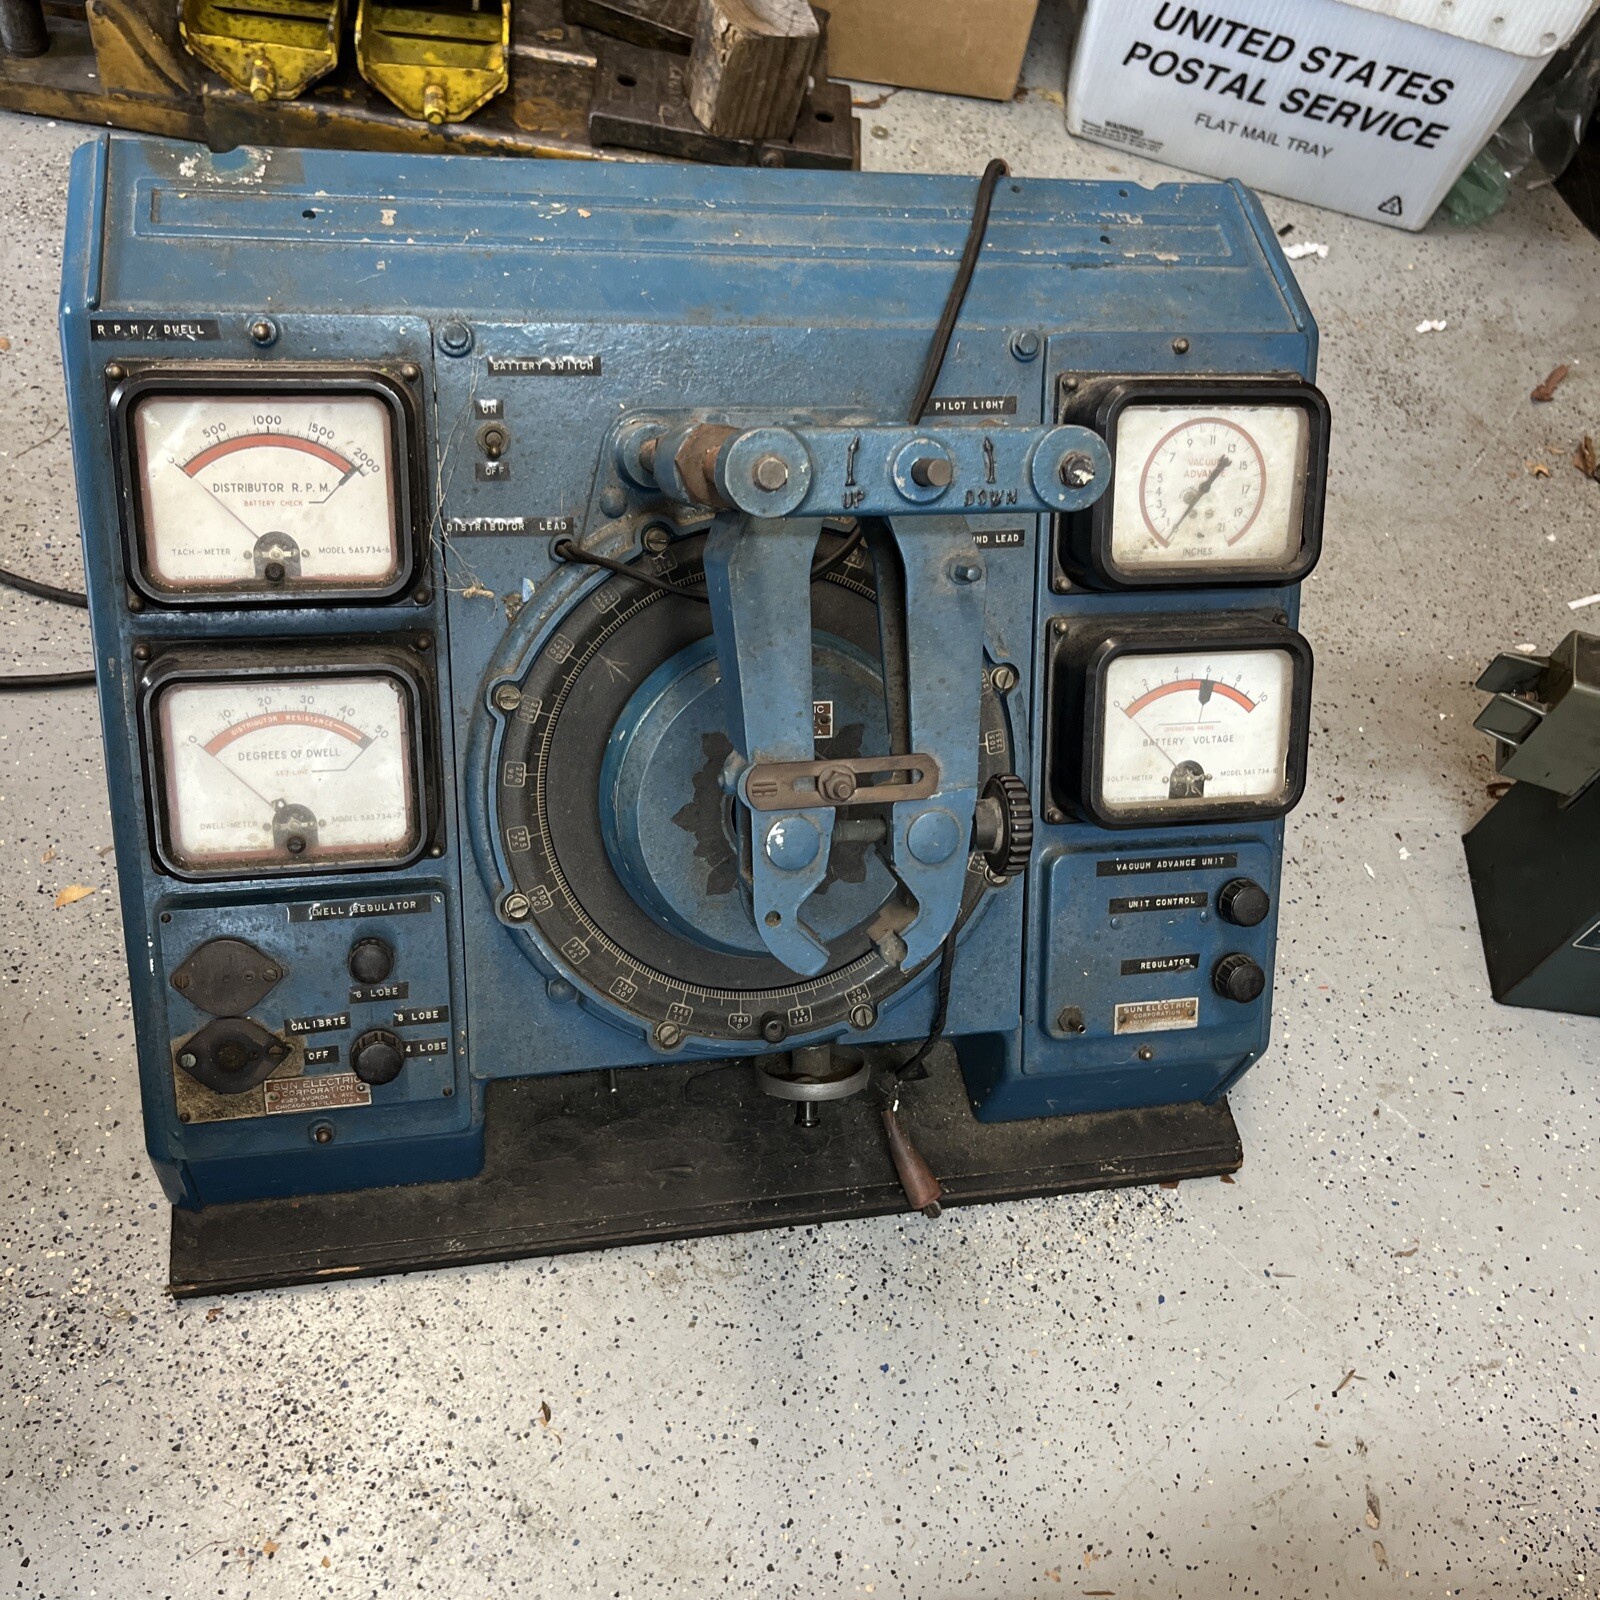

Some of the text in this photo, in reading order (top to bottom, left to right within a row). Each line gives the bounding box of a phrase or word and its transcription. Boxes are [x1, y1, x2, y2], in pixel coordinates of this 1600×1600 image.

[1153, 1, 1455, 106] UNITED STATES
[1122, 40, 1450, 149] POSTAL SERVICE
[1194, 112, 1334, 158] FLAT MAIL TRAY
[163, 324, 205, 335] DWELL
[493, 360, 594, 371] BATTERY SWITCH
[482, 404, 497, 414] ON
[934, 399, 1005, 411] PILOT LIGHT
[253, 415, 282, 426] 1000
[202, 422, 227, 439] 500
[308, 422, 336, 440] 1500
[1187, 438, 1194, 449] 9
[1210, 435, 1216, 445] 11
[1227, 443, 1237, 454] 13
[353, 447, 380, 474] 2000
[1169, 452, 1176, 463] 7
[1239, 461, 1248, 470] 15
[485, 467, 505, 476] OFF
[1157, 474, 1163, 484] 5
[213, 482, 284, 493] DISTRIBUTOR
[1156, 487, 1162, 496] 4
[1241, 485, 1250, 494] 17
[244, 499, 303, 507] BATTERY CHECK
[842, 489, 865, 509] UP
[964, 488, 1018, 508] DOWN
[1156, 500, 1163, 509] 3
[1161, 508, 1167, 518] 2
[1234, 507, 1243, 517] 19
[446, 520, 567, 531] DISTRIBUTOR LEAD
[1167, 518, 1171, 527] 1
[1217, 523, 1226, 532] 21
[995, 534, 1019, 543] LEAD
[319, 546, 346, 554] MODEL
[1182, 546, 1213, 557] INCHES
[1174, 666, 1179, 674] 4
[1205, 665, 1212, 673] 6
[1142, 678, 1148, 687] 2
[1236, 674, 1242, 682] 8
[257, 696, 272, 707] 20
[299, 694, 315, 705] 30
[1259, 691, 1268, 702] 10
[1113, 700, 1120, 708] 0
[220, 709, 231, 720] 10
[340, 705, 355, 717] 40
[231, 714, 334, 736] DISTRIBUTOR RESISTANCE
[374, 724, 389, 739] 50
[188, 735, 197, 744] 0
[1142, 734, 1234, 747] BATTERY VOLTAGE
[238, 748, 341, 761] DEGREES OF DWELL
[515, 766, 523, 783] 270
[1220, 769, 1242, 777] MODEL
[1116, 857, 1225, 871] VACUUM ADVANCE UNIT
[531, 896, 541, 907] 60
[537, 889, 549, 906] 300
[1128, 897, 1196, 909] UNIT CONTROL
[352, 901, 417, 913] REGULATOR
[571, 941, 586, 957] 315
[1140, 958, 1191, 970] REGULATOR
[371, 987, 398, 997] LOBE
[615, 988, 627, 998] 30
[617, 981, 633, 994] 330
[852, 988, 862, 996] 30
[673, 1006, 689, 1017] 345
[1124, 1001, 1191, 1014] SUN ELECTRIC
[397, 1010, 439, 1022] 8 LOBE
[674, 1014, 684, 1023] 15
[795, 1009, 805, 1018] 15
[1133, 1010, 1180, 1019] CORPORATION
[291, 1016, 346, 1031] CALIBRTE
[732, 1016, 749, 1024] 360
[793, 1015, 809, 1024] 345
[405, 1041, 447, 1053] 4 LOBE
[308, 1050, 329, 1060] OFF
[273, 1075, 361, 1091] SUN ELECTRIC
[282, 1085, 353, 1097] CORPORATION
